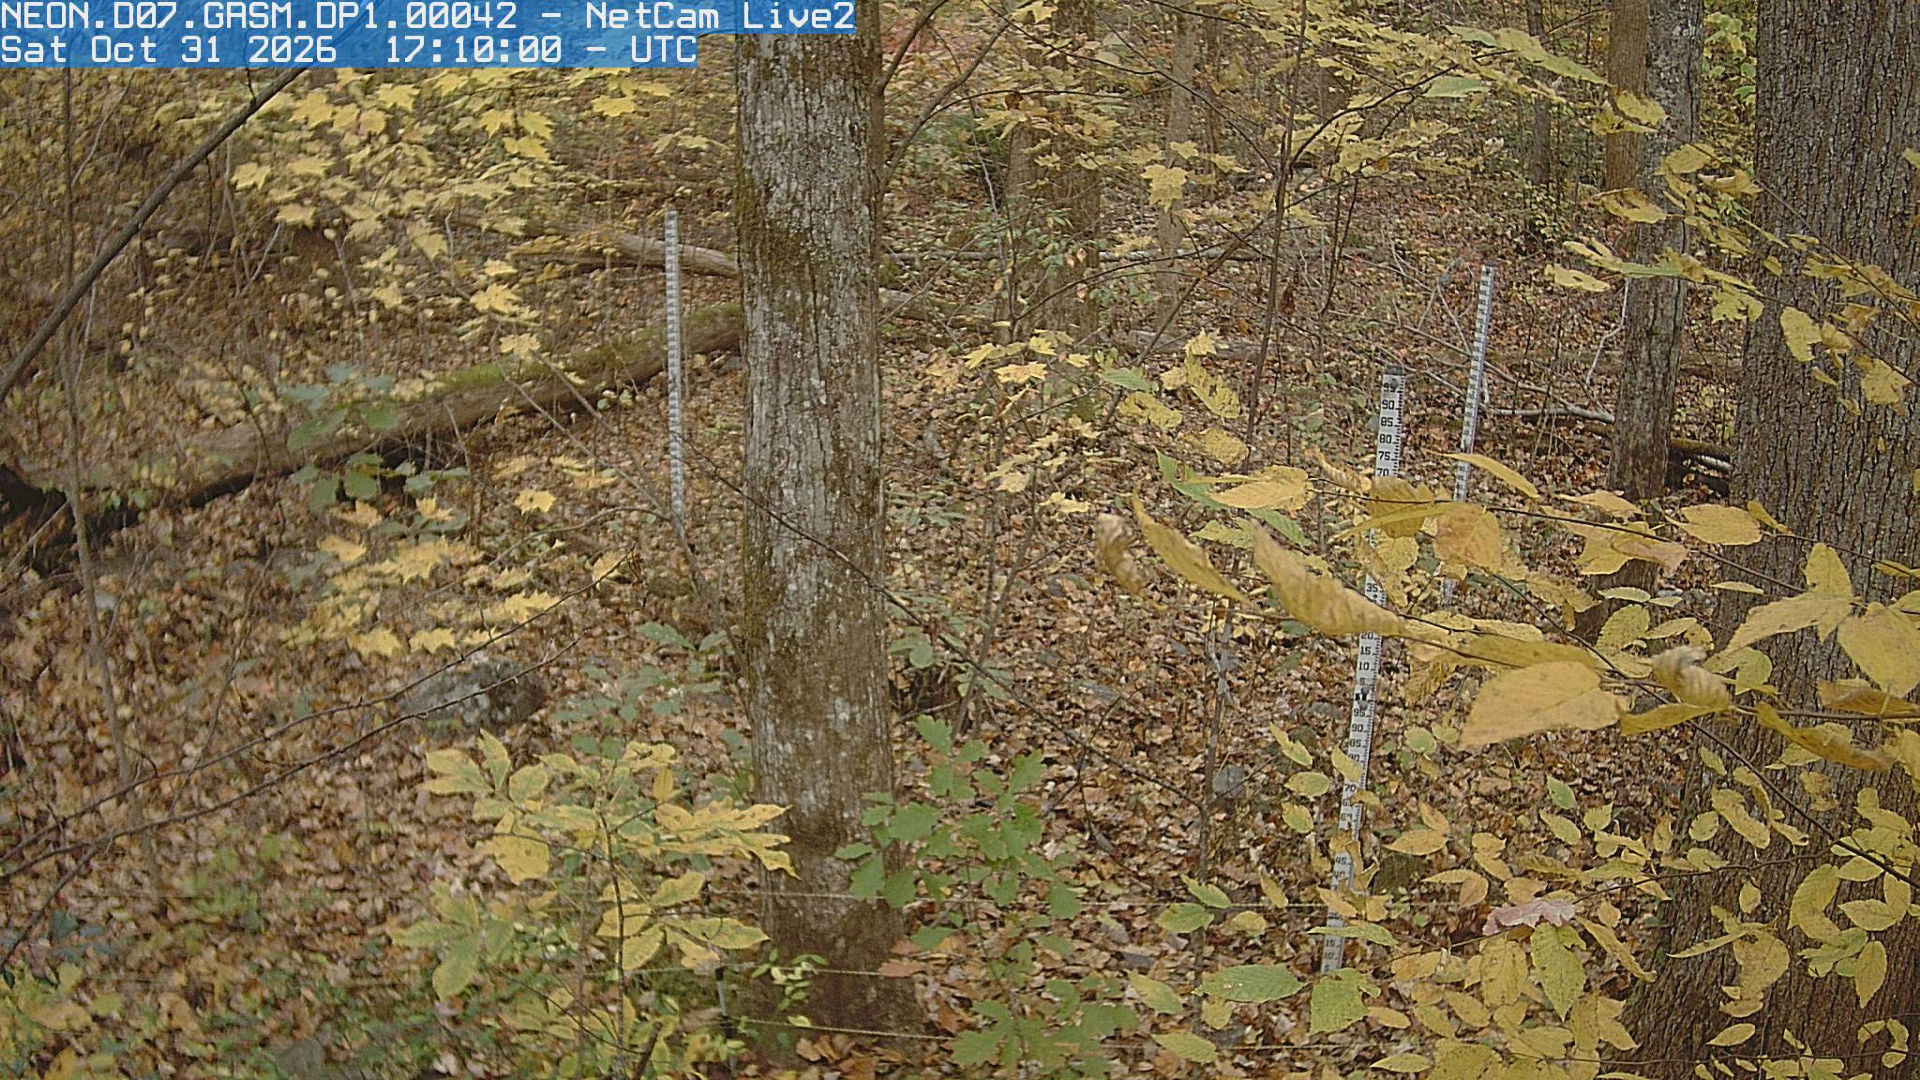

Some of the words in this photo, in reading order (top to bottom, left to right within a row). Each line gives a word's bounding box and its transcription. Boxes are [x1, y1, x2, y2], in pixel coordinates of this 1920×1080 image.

[1382, 400, 1395, 410] 90
[1381, 417, 1394, 427] 85
[1380, 434, 1392, 444] 80
[1378, 451, 1391, 461] 75
[1377, 468, 1389, 477] 70
[1366, 583, 1378, 592] 35
[1360, 646, 1372, 656] 15
[1358, 662, 1370, 671] 10
[1359, 677, 1366, 686] 5
[1354, 708, 1366, 717] 95
[1352, 724, 1364, 732] 90
[1350, 739, 1362, 747] 85
[1345, 784, 1356, 792] 70
